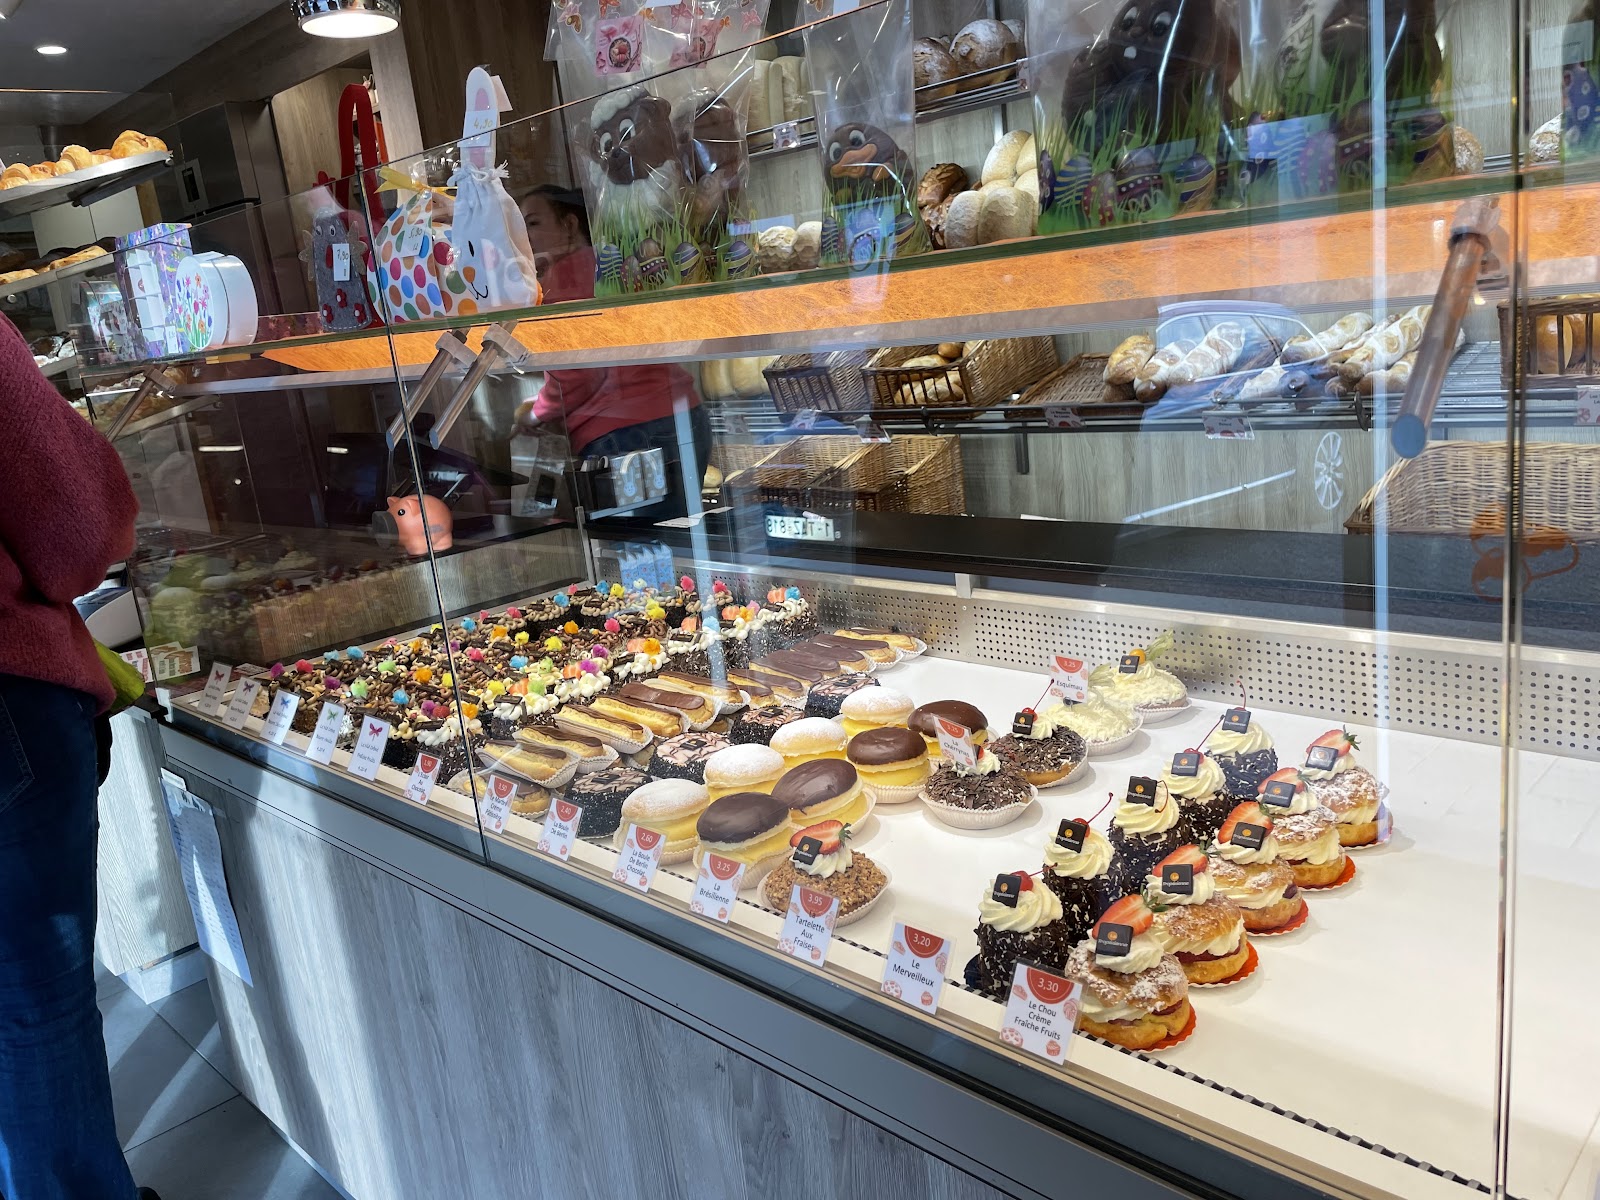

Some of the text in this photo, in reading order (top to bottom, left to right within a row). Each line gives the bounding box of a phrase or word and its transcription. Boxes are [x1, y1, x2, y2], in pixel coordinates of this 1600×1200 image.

[1056, 680, 1083, 691] Esquimau
[558, 823, 569, 832] Boule
[556, 830, 568, 839] Berlin
[641, 832, 653, 843] 2,60
[629, 856, 649, 869] De Berlin
[638, 851, 650, 862] Boule
[626, 864, 645, 877] Chocolat
[716, 861, 730, 872] 3,25
[713, 883, 720, 891] La
[699, 888, 730, 904] Brésilienne
[808, 893, 823, 906] 3,95
[809, 910, 816, 918] La
[795, 915, 825, 934] Tartelette
[801, 929, 813, 940] Aux
[913, 933, 931, 947] 3,20
[793, 936, 814, 952] Fraises
[911, 959, 920, 970] Le
[892, 963, 935, 987] Merveilleux
[1037, 978, 1059, 993] 3,30
[1028, 1000, 1057, 1017] Le Chou
[1028, 1011, 1052, 1026] Crème
[1014, 1016, 1061, 1041] Fraîche Fruits
